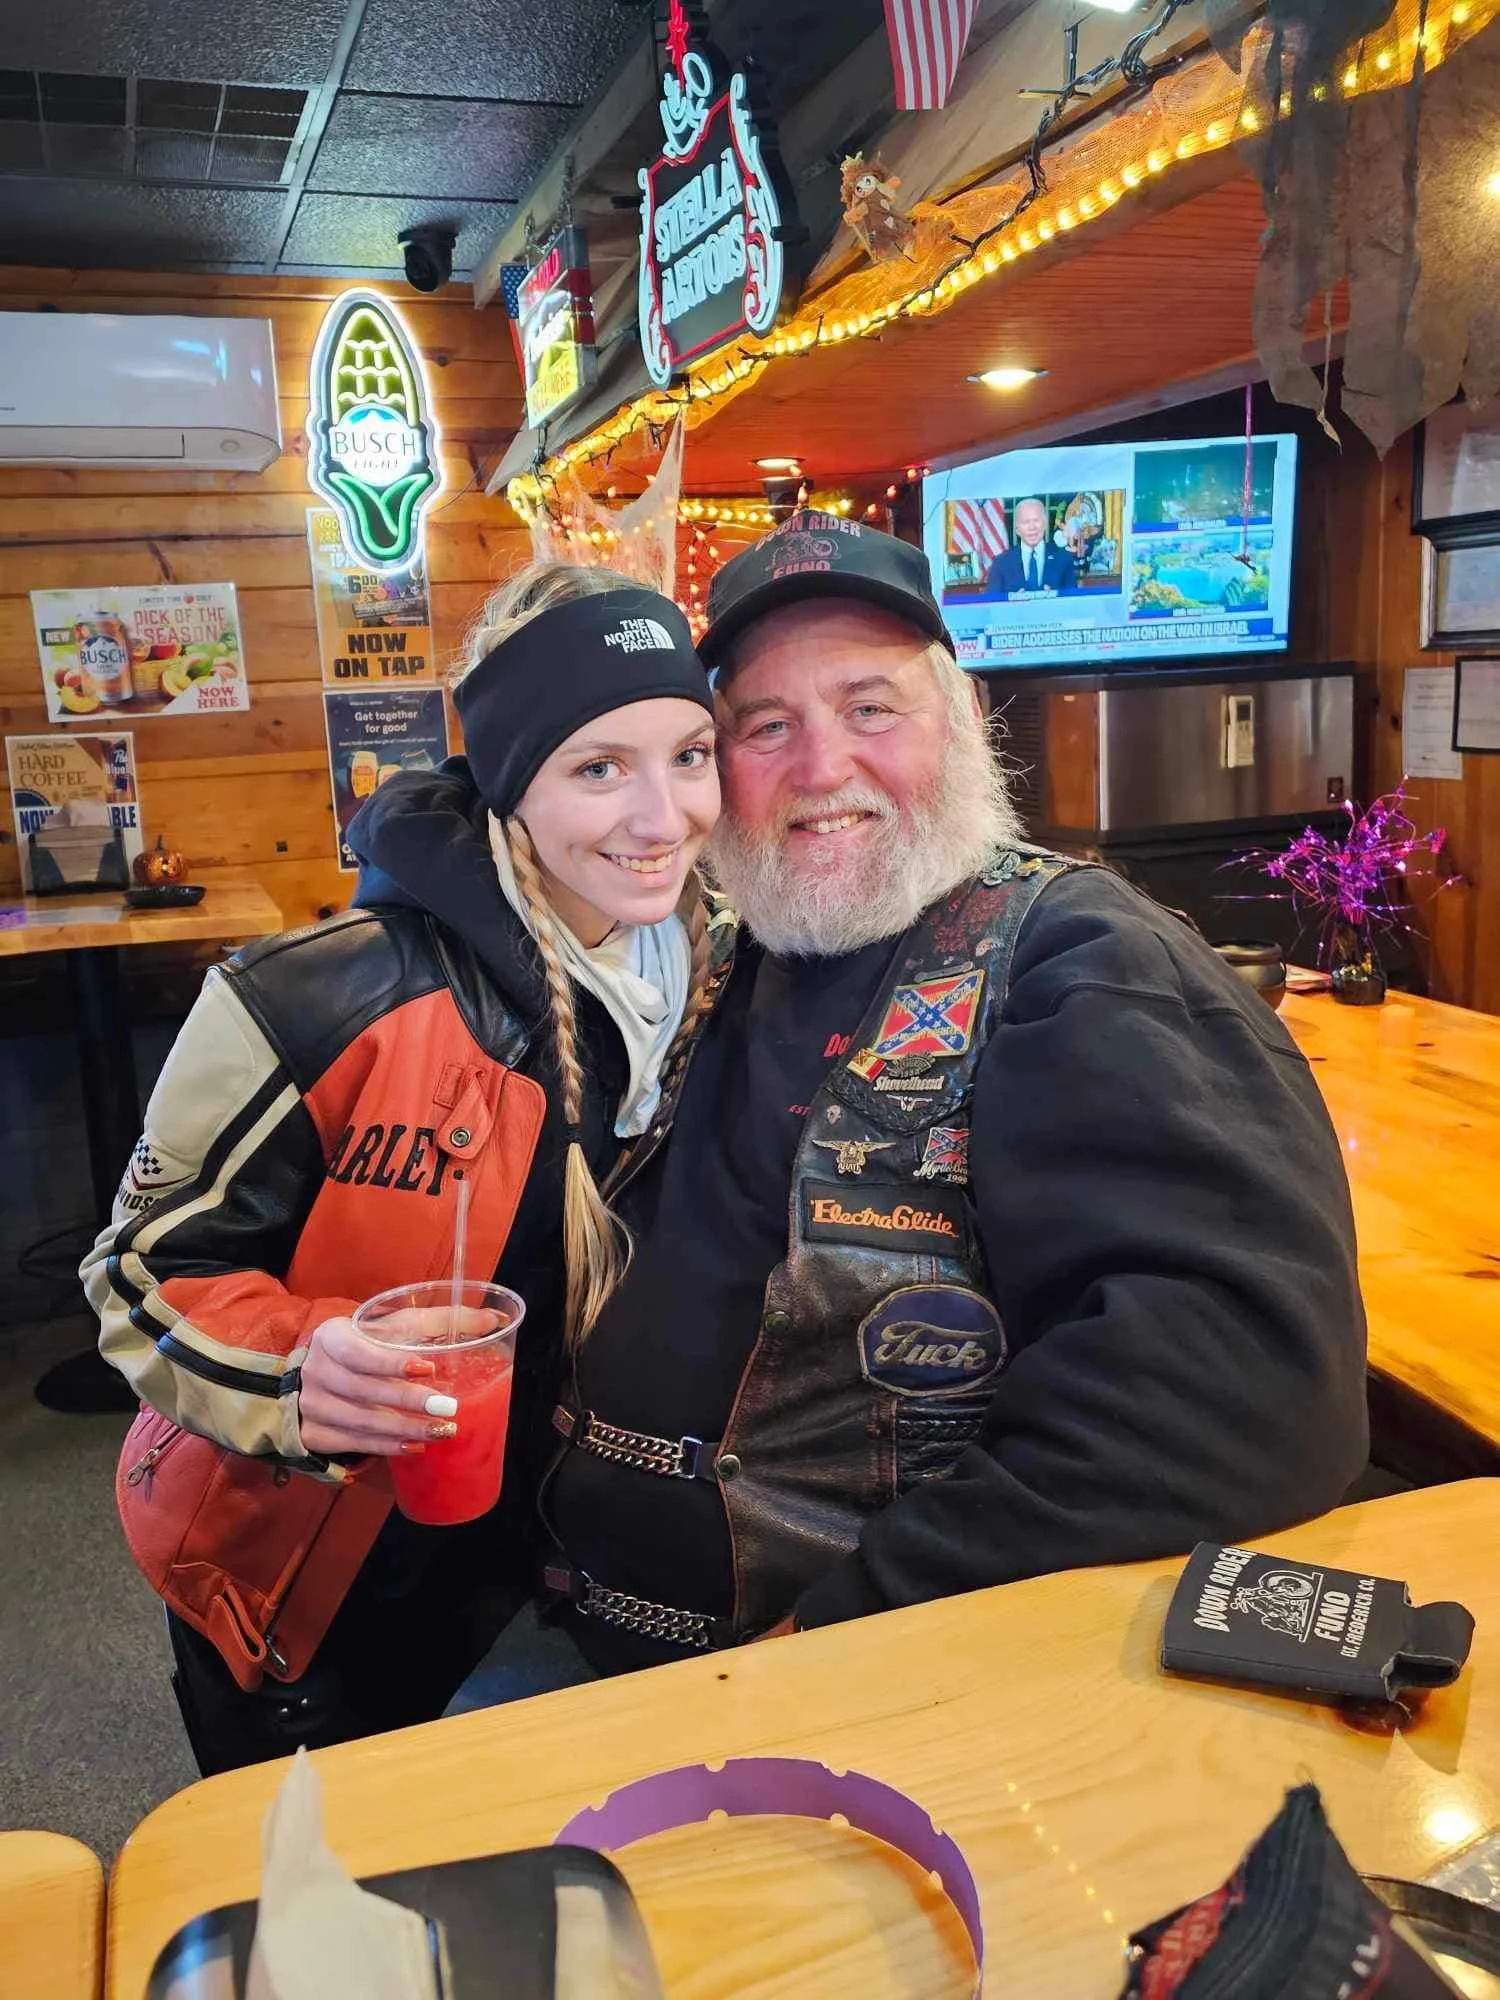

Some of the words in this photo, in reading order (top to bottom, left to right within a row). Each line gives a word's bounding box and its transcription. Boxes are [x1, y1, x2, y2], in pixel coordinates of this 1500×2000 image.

[654, 147, 743, 262] STELLA
[662, 213, 746, 325] ARTOIS
[334, 431, 416, 457] BUSCH
[808, 514, 862, 538] RIDER
[174, 608, 192, 623] OF
[620, 618, 645, 631] THE
[46, 632, 70, 644] NEW
[143, 625, 220, 645] SEASON
[347, 633, 408, 654] NOW
[603, 625, 651, 647] NORTH
[991, 635, 1021, 649] BIDEN
[1022, 629, 1082, 648] ADDRESSES
[1101, 626, 1140, 643] NATION
[1177, 622, 1201, 638] WAR
[1213, 620, 1248, 636] ISRAEL
[622, 638, 657, 654] FACE
[80, 649, 127, 665] BUSCH
[333, 657, 369, 678] ON
[377, 656, 425, 677] TAP
[198, 697, 240, 708] HERE
[199, 687, 234, 698] NOW
[354, 711, 374, 721] Get
[375, 710, 418, 722] together
[365, 724, 381, 734] for
[382, 722, 408, 735] good
[18, 752, 66, 772] HARD
[20, 770, 88, 788] COFFEE
[1208, 1547, 1258, 1587] RIDER
[1357, 1578, 1377, 1592] CO.
[1193, 1583, 1231, 1632] DOWN
[1314, 1591, 1351, 1642] FUND
[1344, 1592, 1374, 1646] FREDERICK
